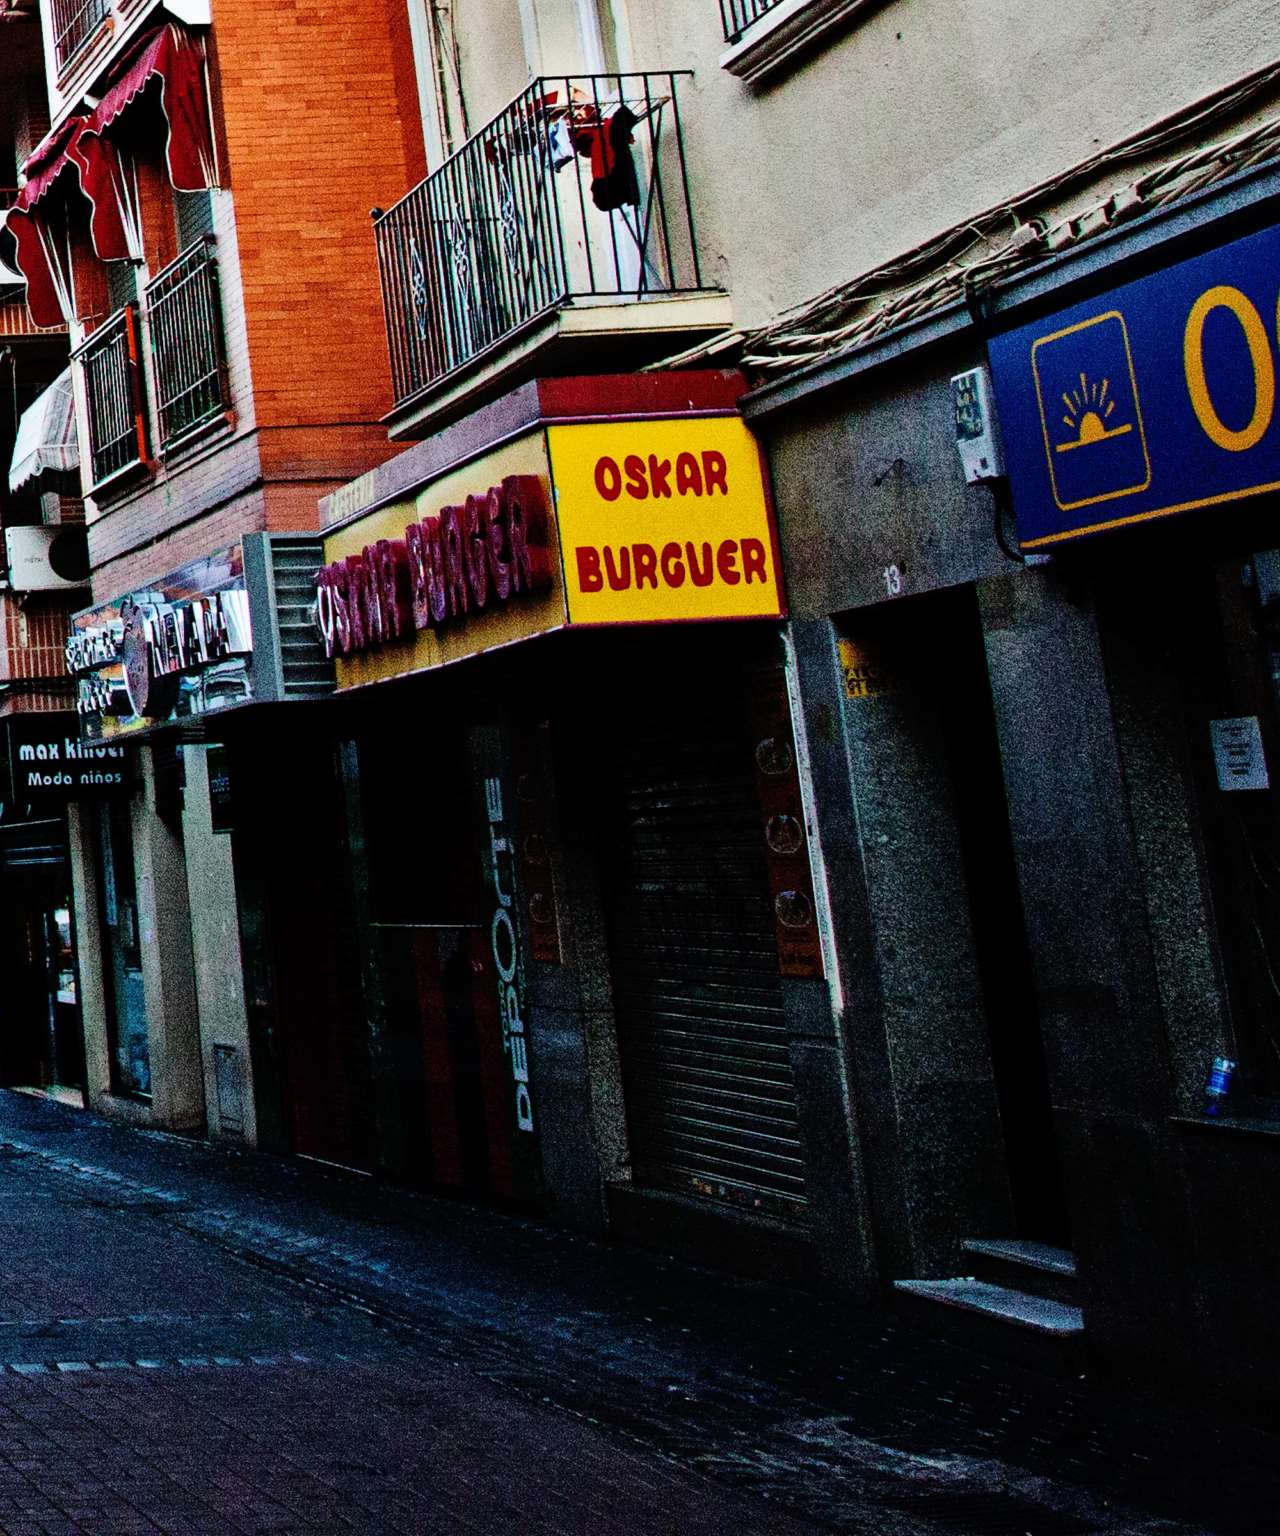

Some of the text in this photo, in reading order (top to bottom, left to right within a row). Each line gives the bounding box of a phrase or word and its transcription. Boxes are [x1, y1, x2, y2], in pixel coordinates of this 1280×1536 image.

[1183, 285, 1280, 452] O
[594, 449, 728, 502] OSKAR
[575, 538, 767, 594] BURGUER
[883, 565, 903, 596] 13
[19, 743, 60, 761] max
[28, 770, 122, 786] Moda niños
